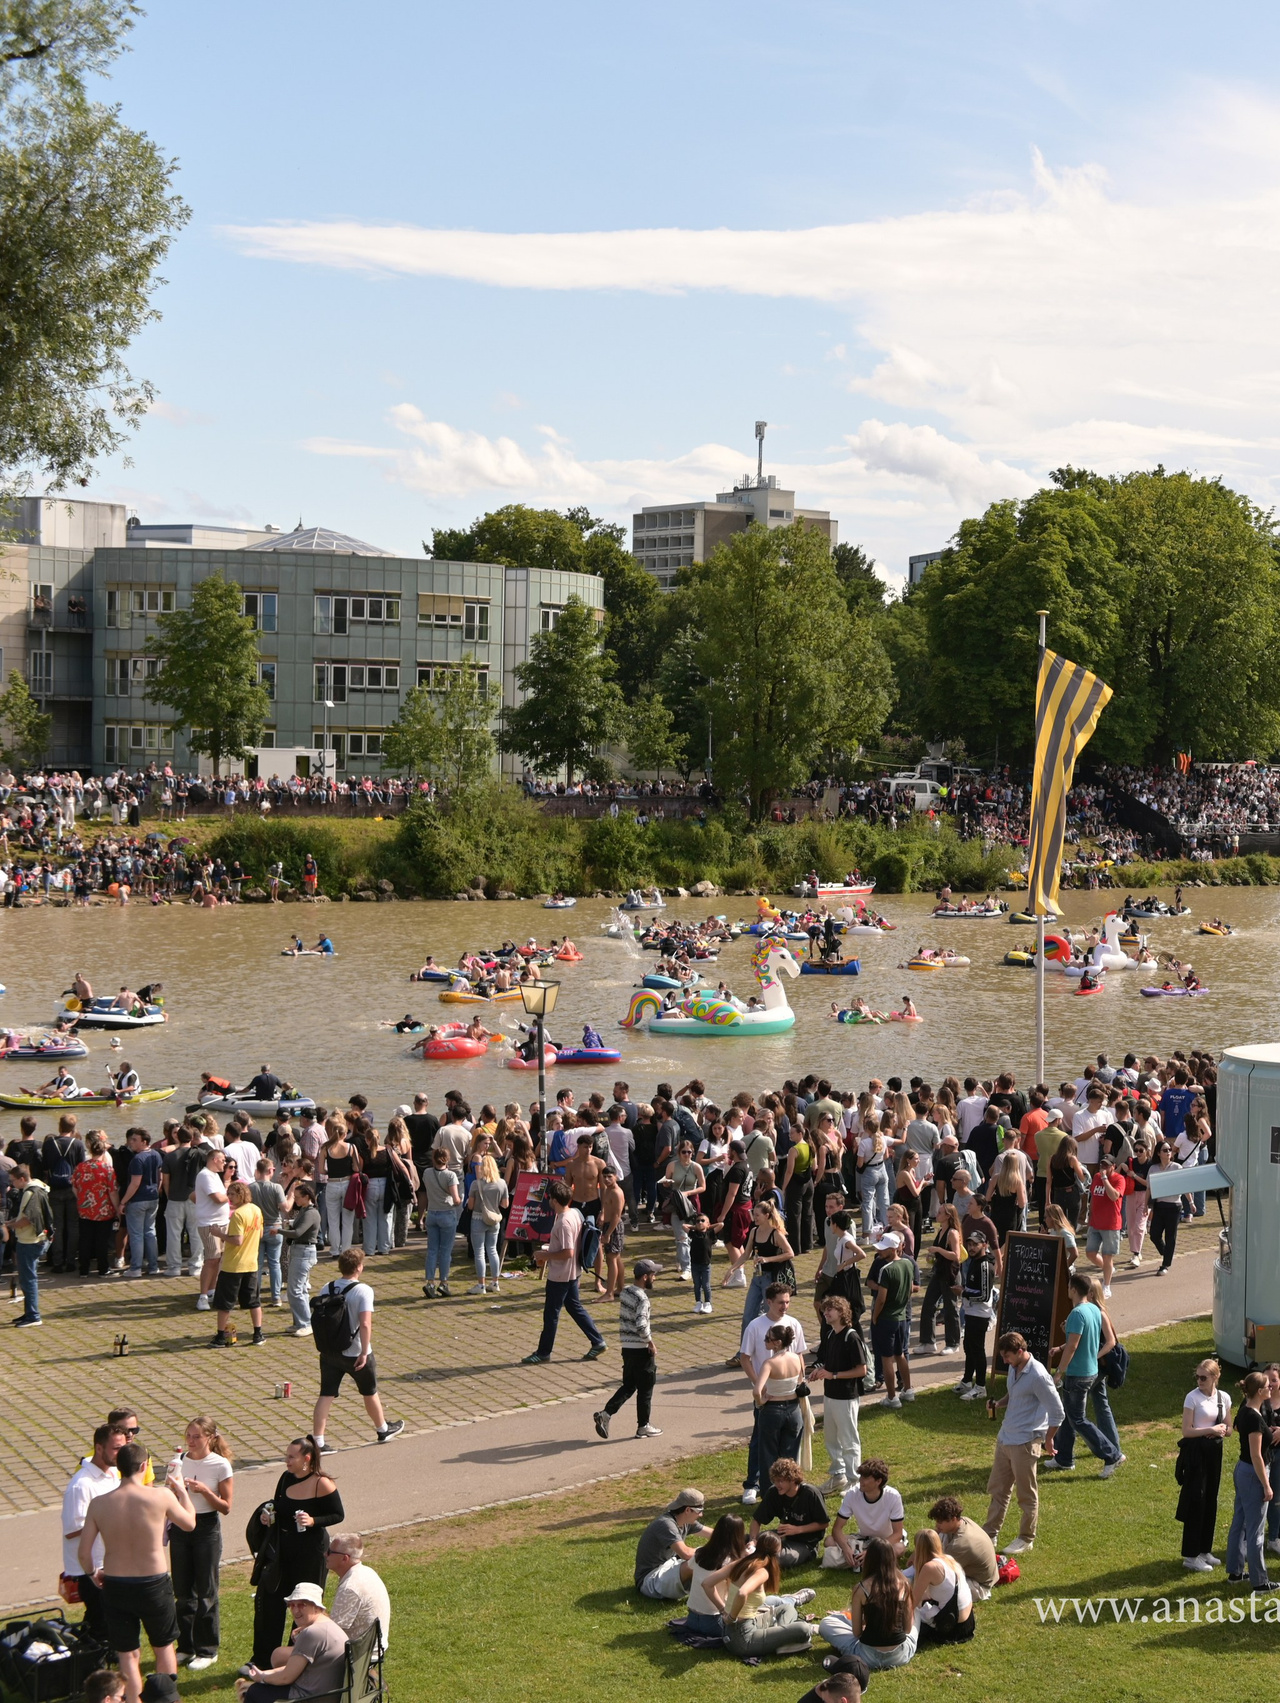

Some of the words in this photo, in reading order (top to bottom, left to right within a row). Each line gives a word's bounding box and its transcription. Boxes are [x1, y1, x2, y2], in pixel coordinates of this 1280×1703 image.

[1094, 1184, 1105, 1195] HH
[1015, 1244, 1043, 1260] FROZEN
[1019, 1260, 1049, 1275] YOGURT
